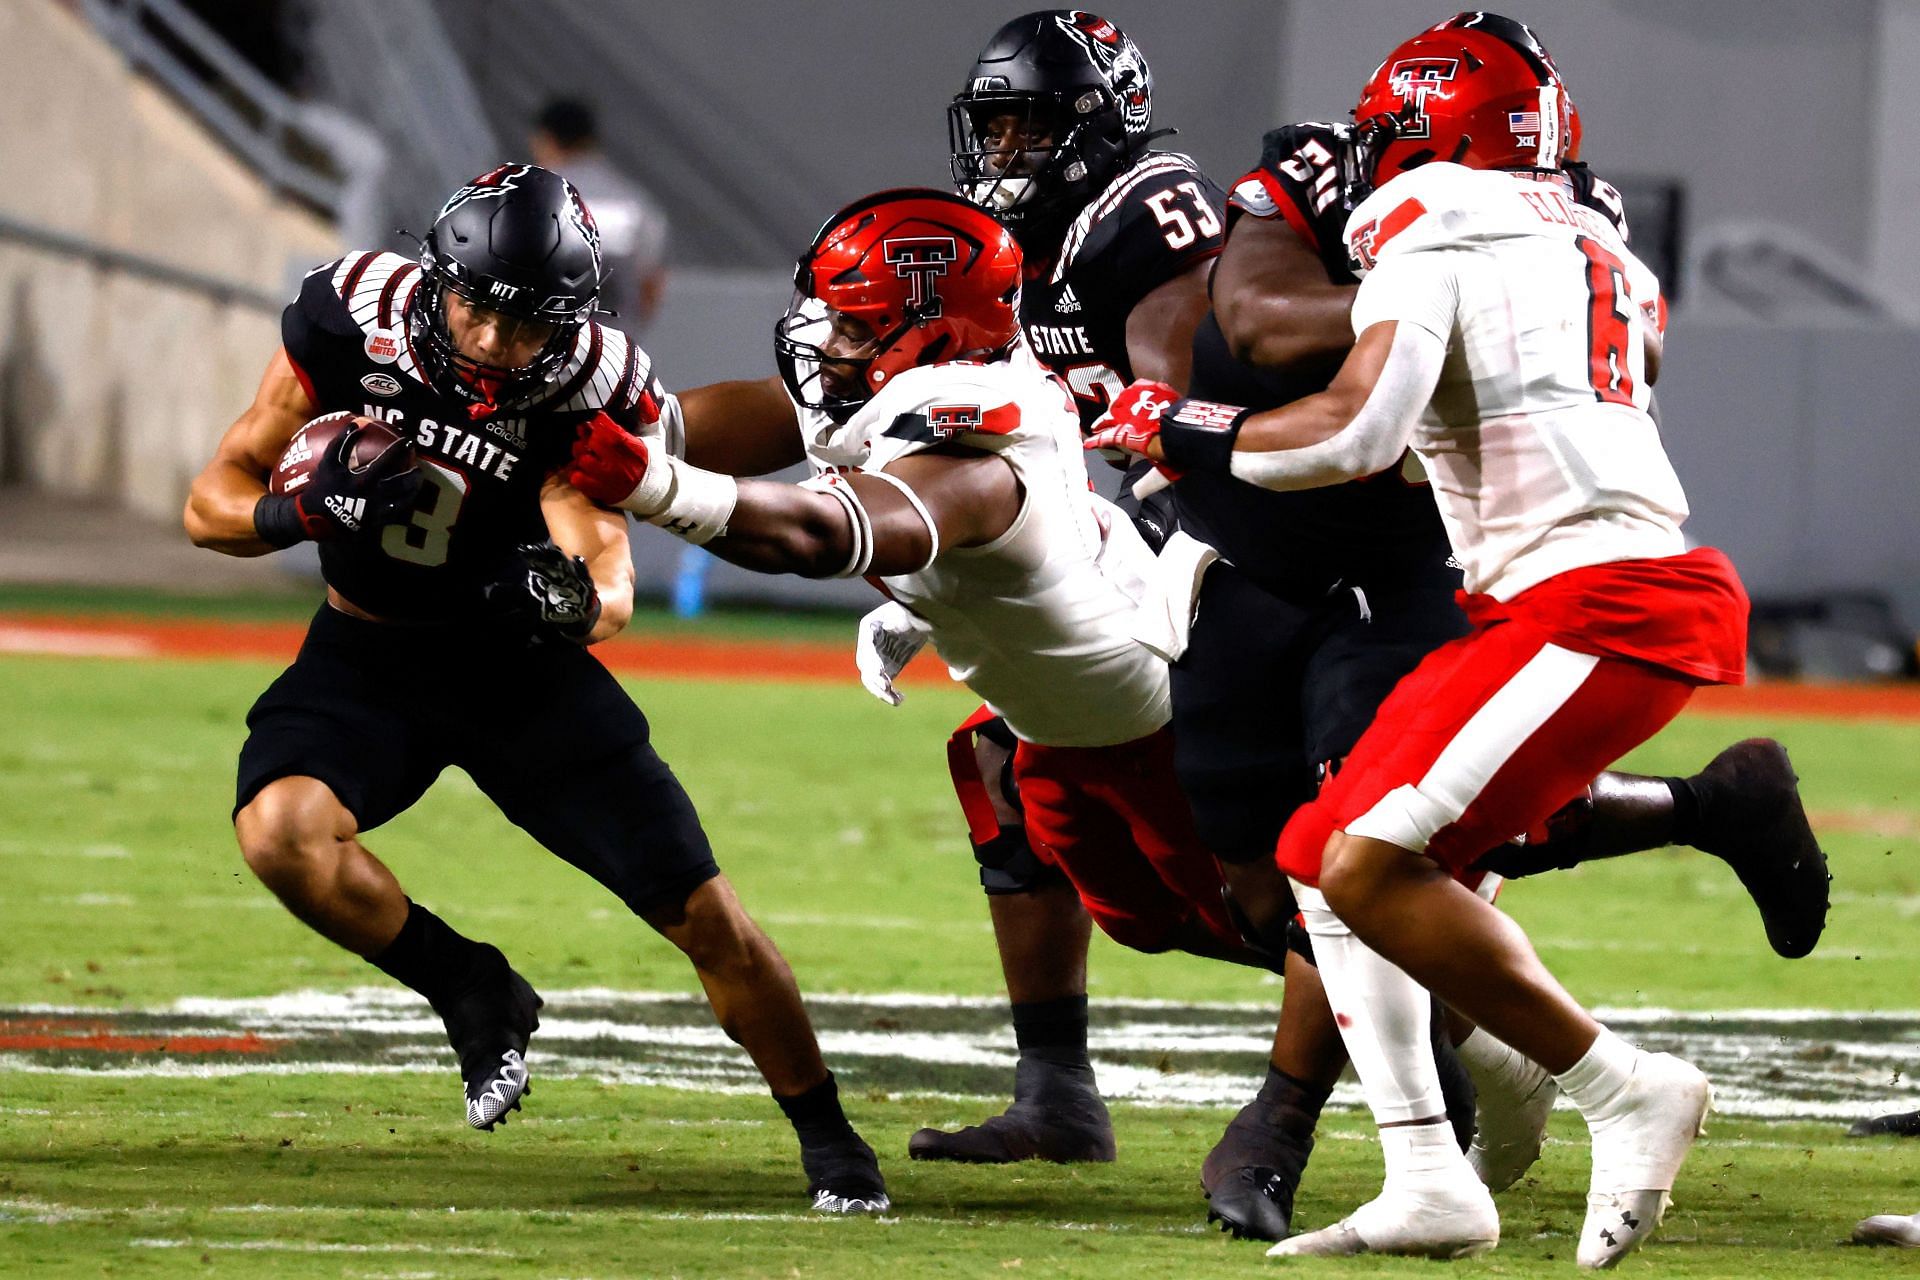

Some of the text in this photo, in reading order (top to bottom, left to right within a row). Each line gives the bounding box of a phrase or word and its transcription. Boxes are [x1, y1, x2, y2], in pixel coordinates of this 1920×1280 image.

[1145, 181, 1221, 250] 53
[490, 281, 519, 300] HTT
[1054, 300, 1082, 313] adidas
[1575, 234, 1637, 407] 6
[368, 345, 397, 357] UNITED
[373, 336, 395, 346] PACK
[1030, 325, 1095, 354] STATE
[367, 379, 397, 392] ACC
[363, 404, 520, 482] NC STATE
[485, 423, 528, 450] adidas
[280, 449, 313, 473] adidas
[324, 496, 361, 532] adidas
[381, 453, 472, 568] 3
